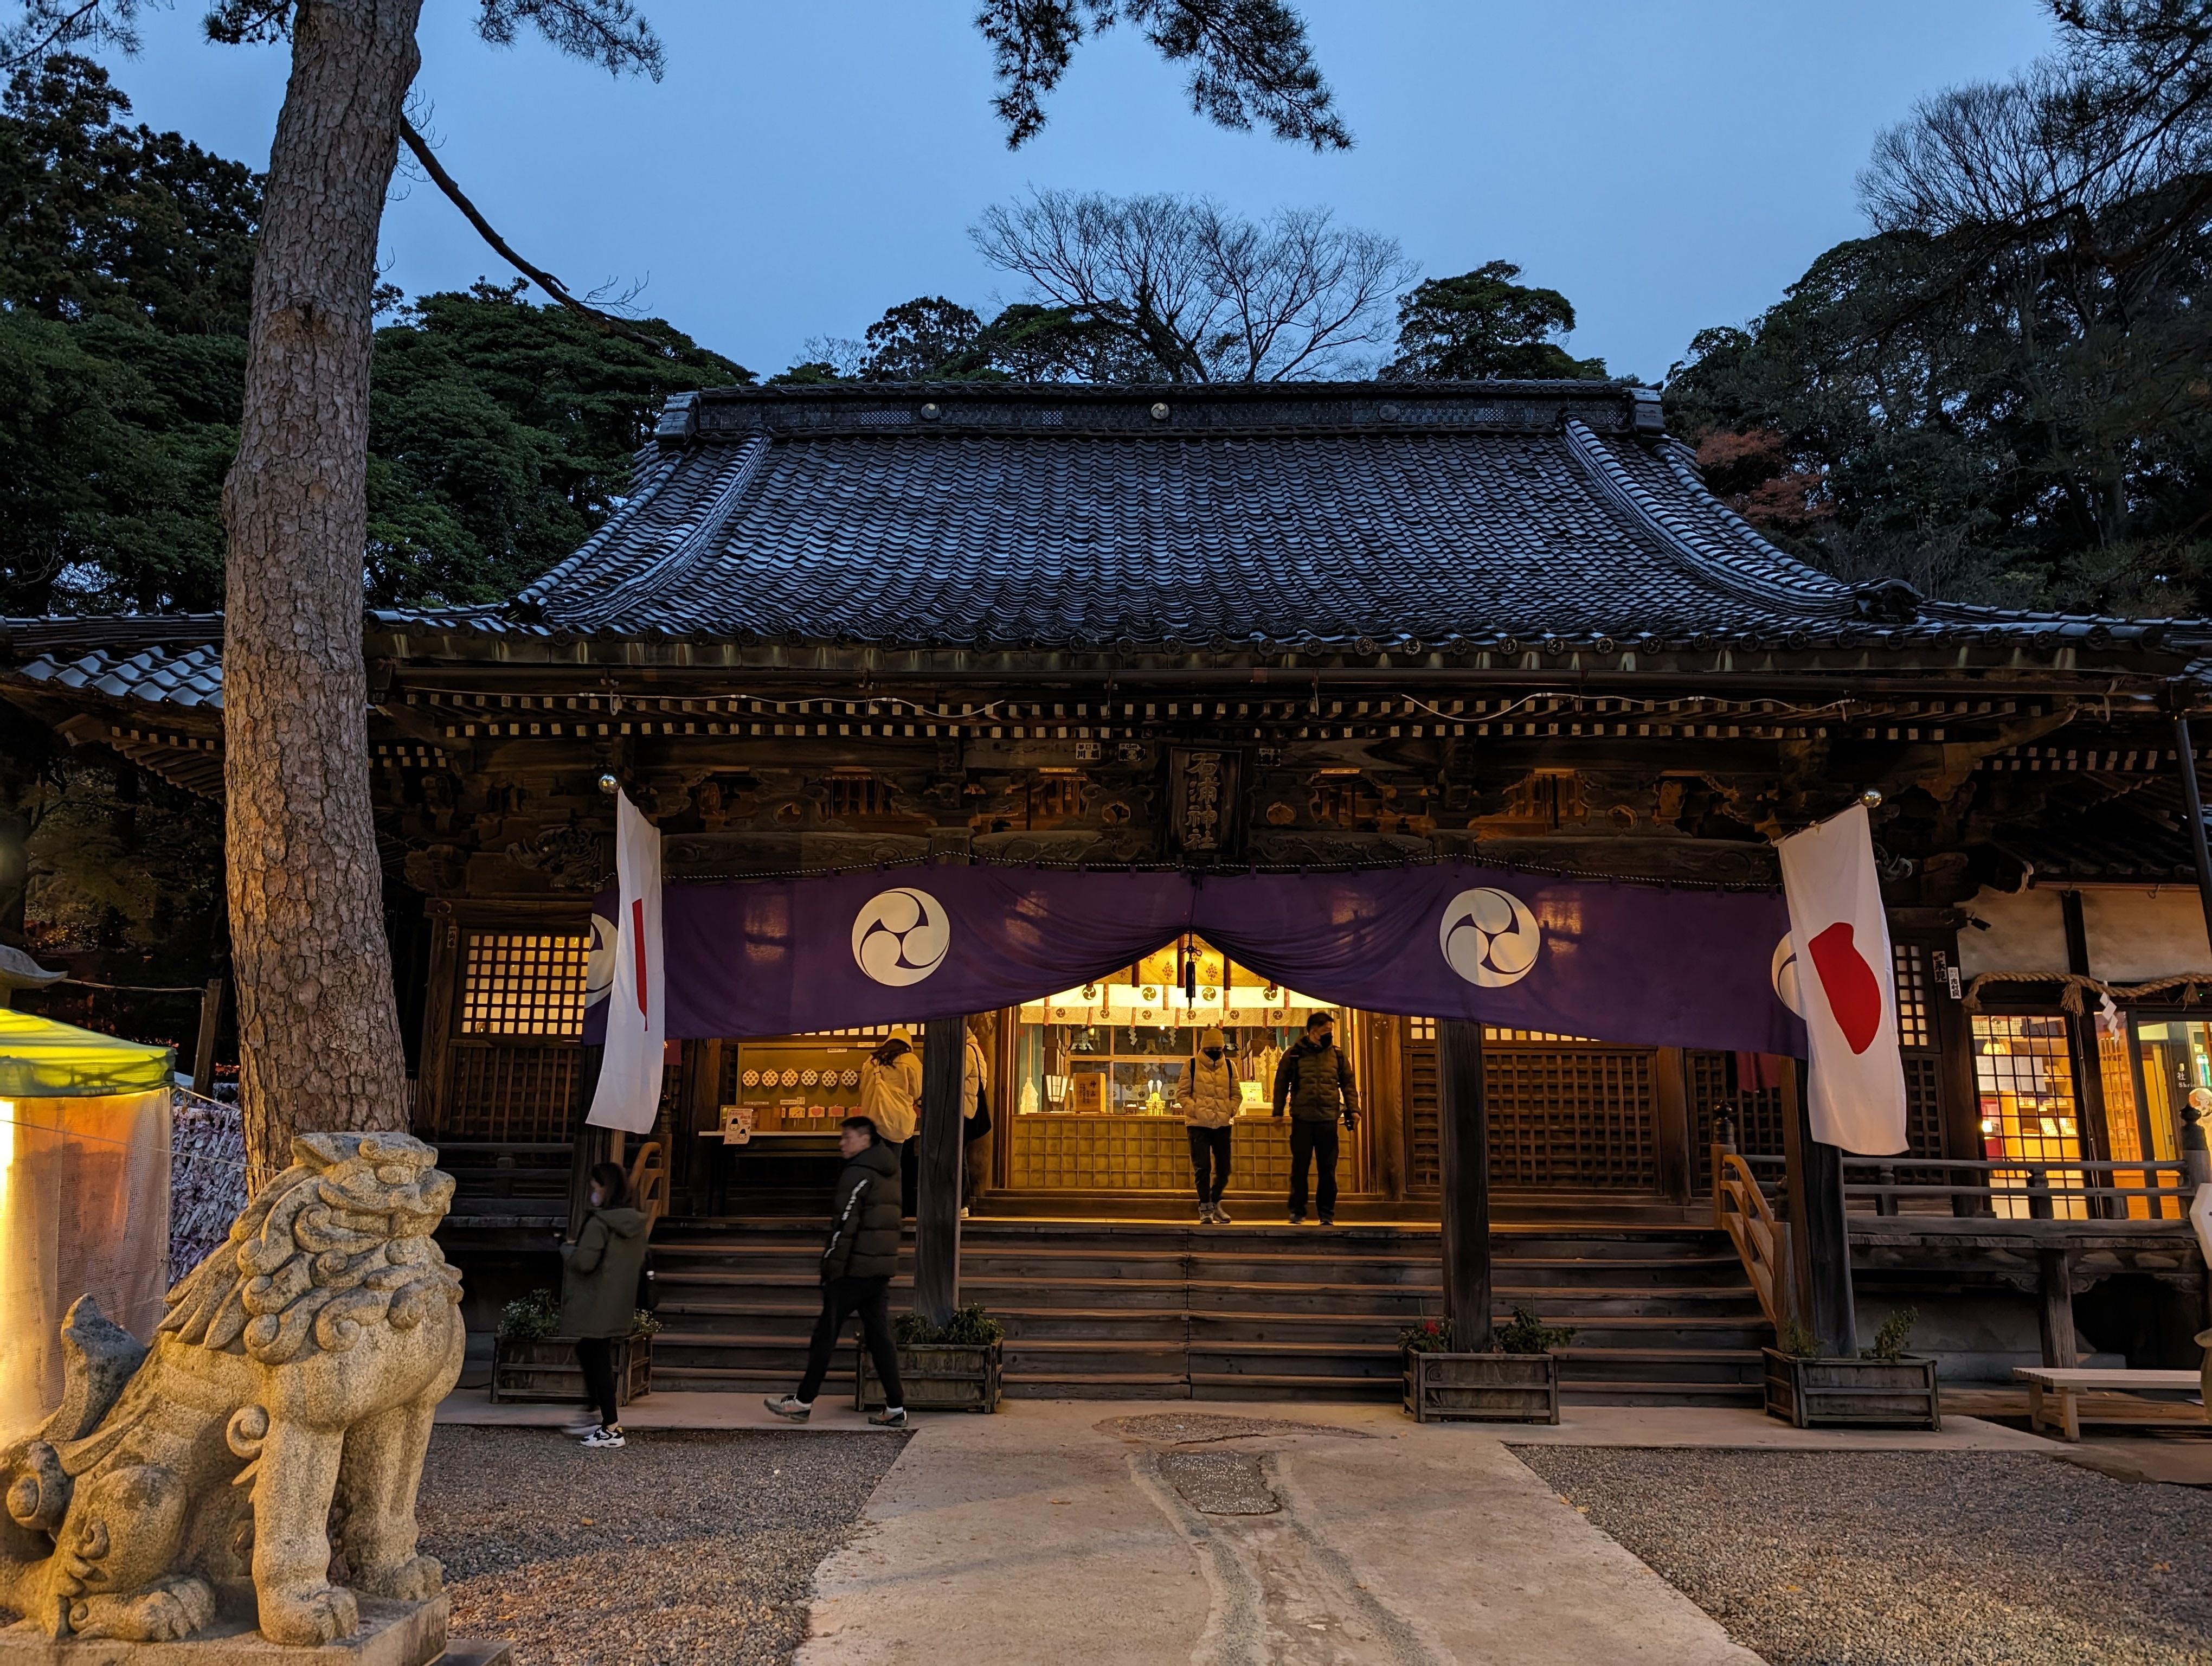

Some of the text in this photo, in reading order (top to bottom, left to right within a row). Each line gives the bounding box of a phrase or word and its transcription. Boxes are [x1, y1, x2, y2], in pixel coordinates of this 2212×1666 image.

[1184, 752, 1222, 850] 石浦神社
[2177, 1072, 2187, 1081] 社
